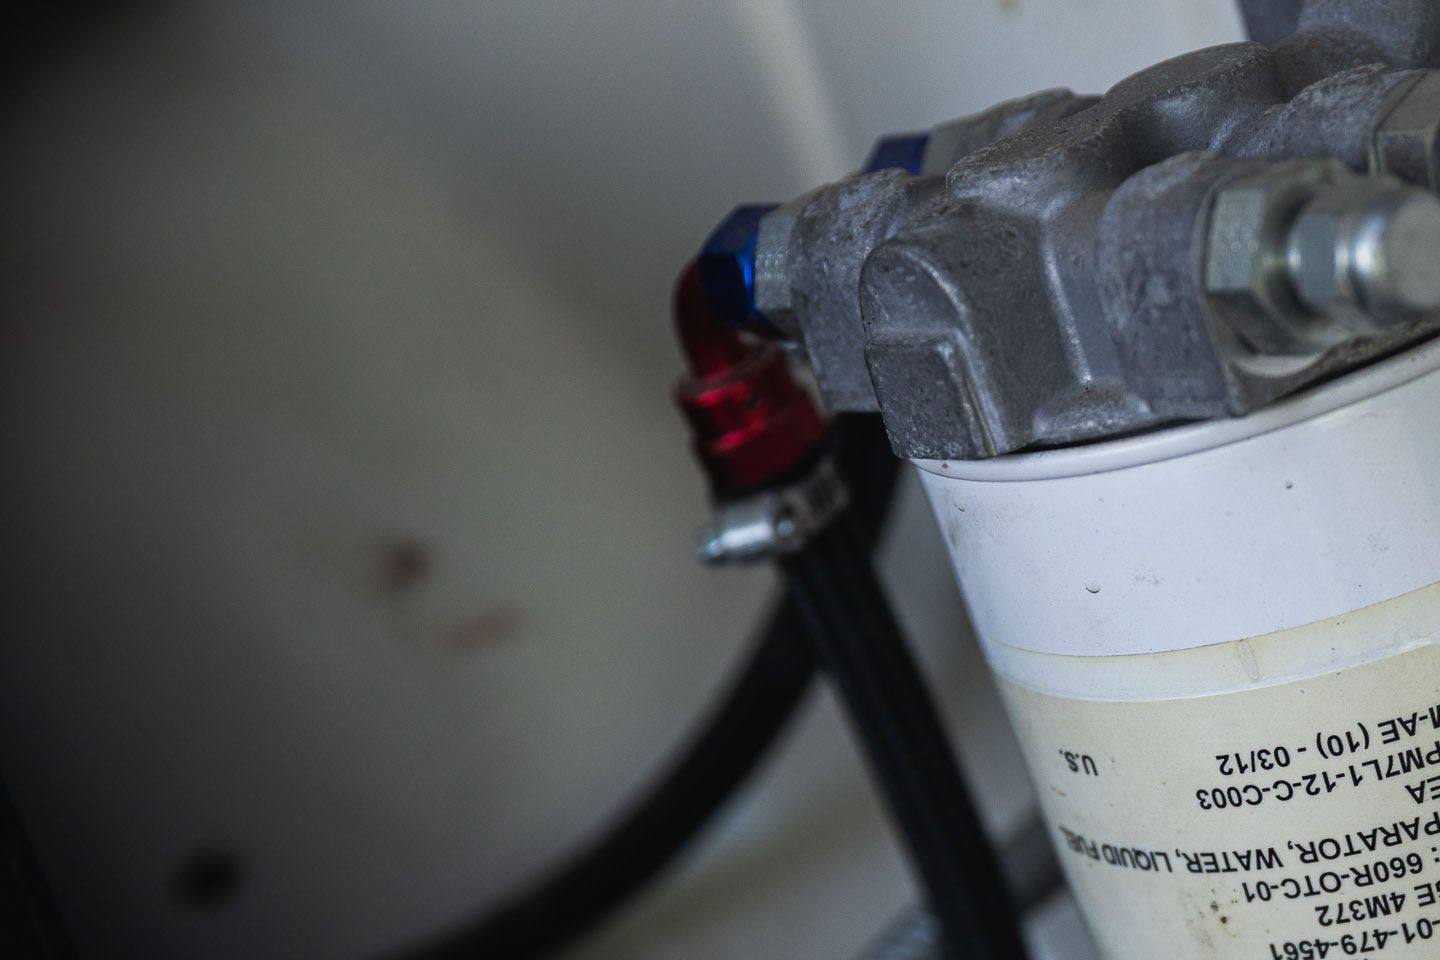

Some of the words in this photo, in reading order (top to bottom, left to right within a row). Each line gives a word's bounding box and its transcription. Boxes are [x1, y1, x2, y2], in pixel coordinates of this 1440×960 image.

[1316, 722, 1370, 760] (10)
[1059, 749, 1099, 777] U.S.
[1215, 745, 1291, 776] 03/12
[1101, 843, 1174, 873] LIQUID
[1174, 847, 1285, 874] WATER,
[1241, 852, 1424, 904] 660R-OTC-01
[1315, 891, 1407, 928] 4M372
